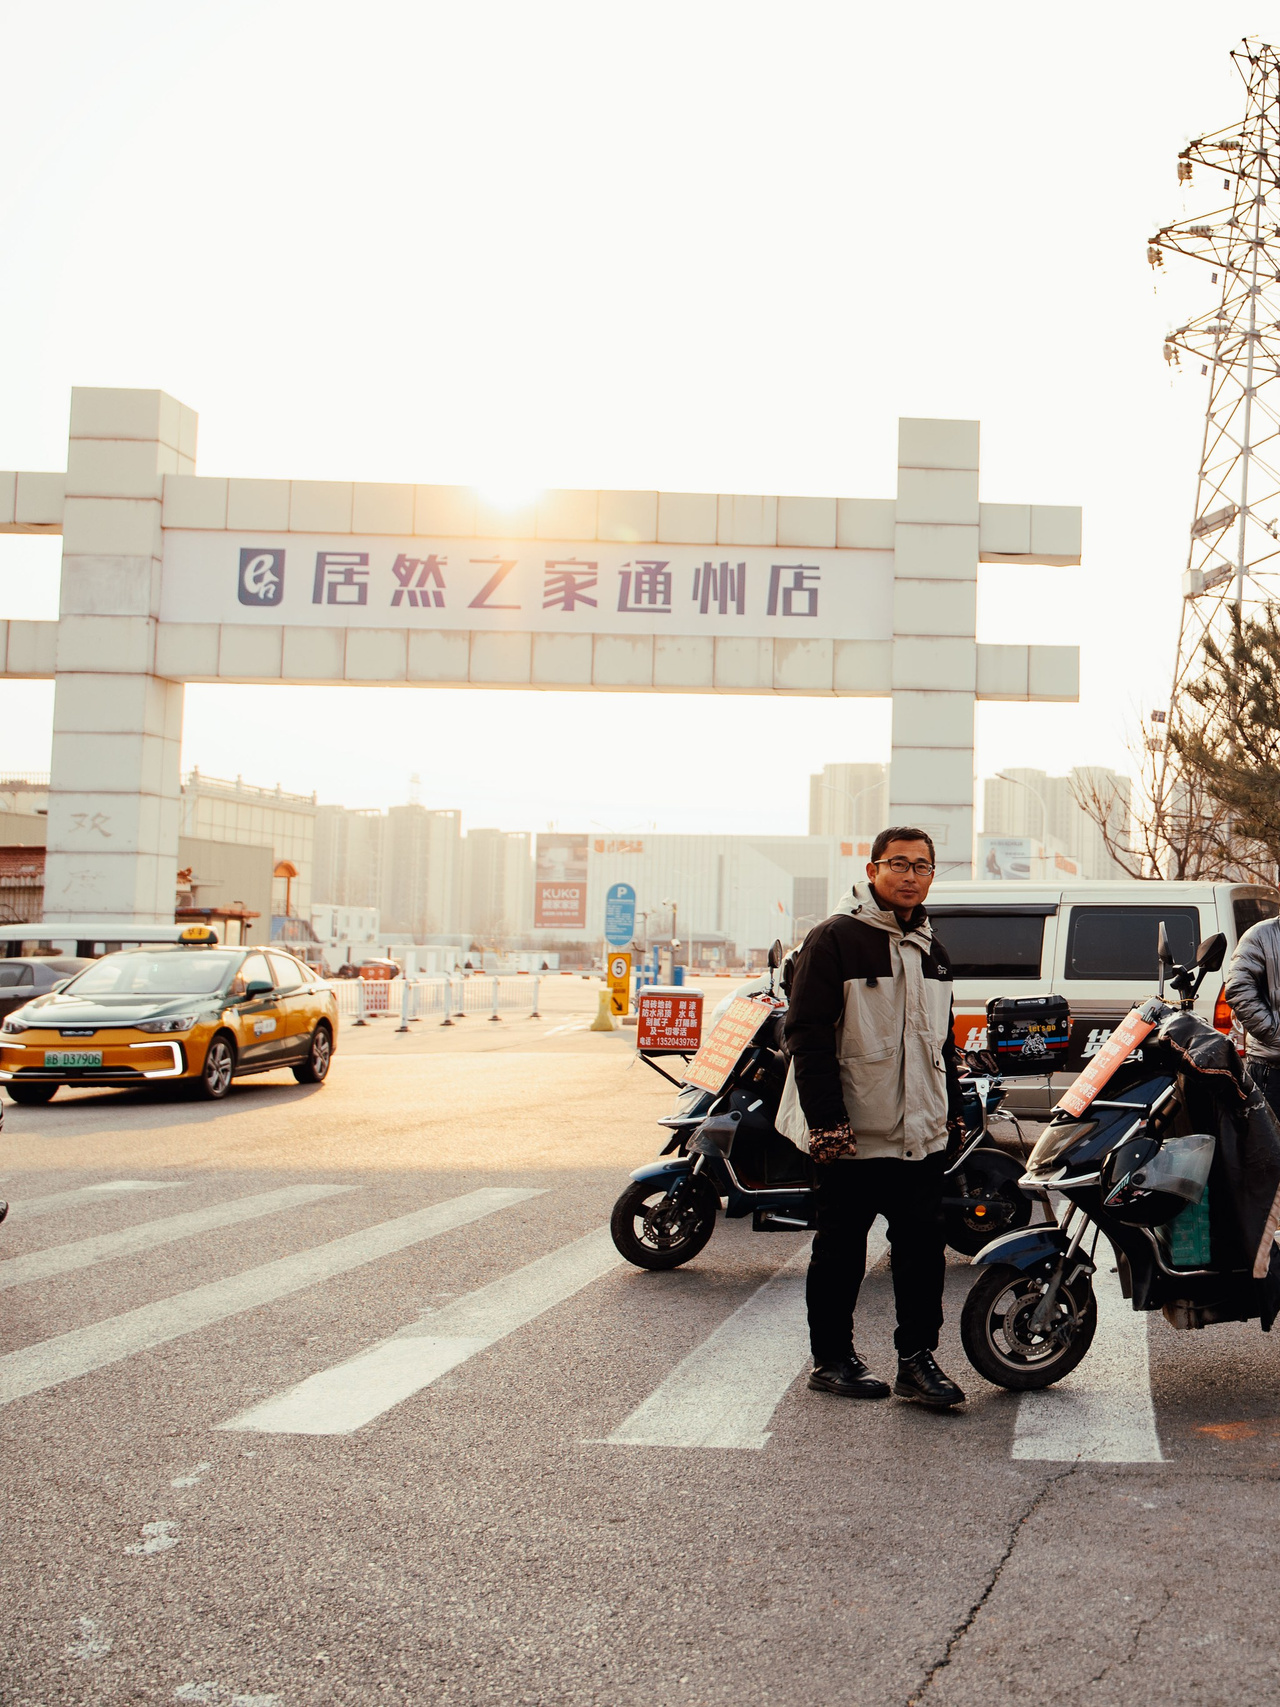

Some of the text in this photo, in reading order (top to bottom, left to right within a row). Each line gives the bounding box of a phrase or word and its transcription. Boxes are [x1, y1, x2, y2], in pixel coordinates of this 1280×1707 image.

[312, 551, 821, 617] 居然之家通州店
[616, 887, 627, 898] P
[615, 961, 623, 975] 5
[650, 1027, 687, 1036] 及一切零活
